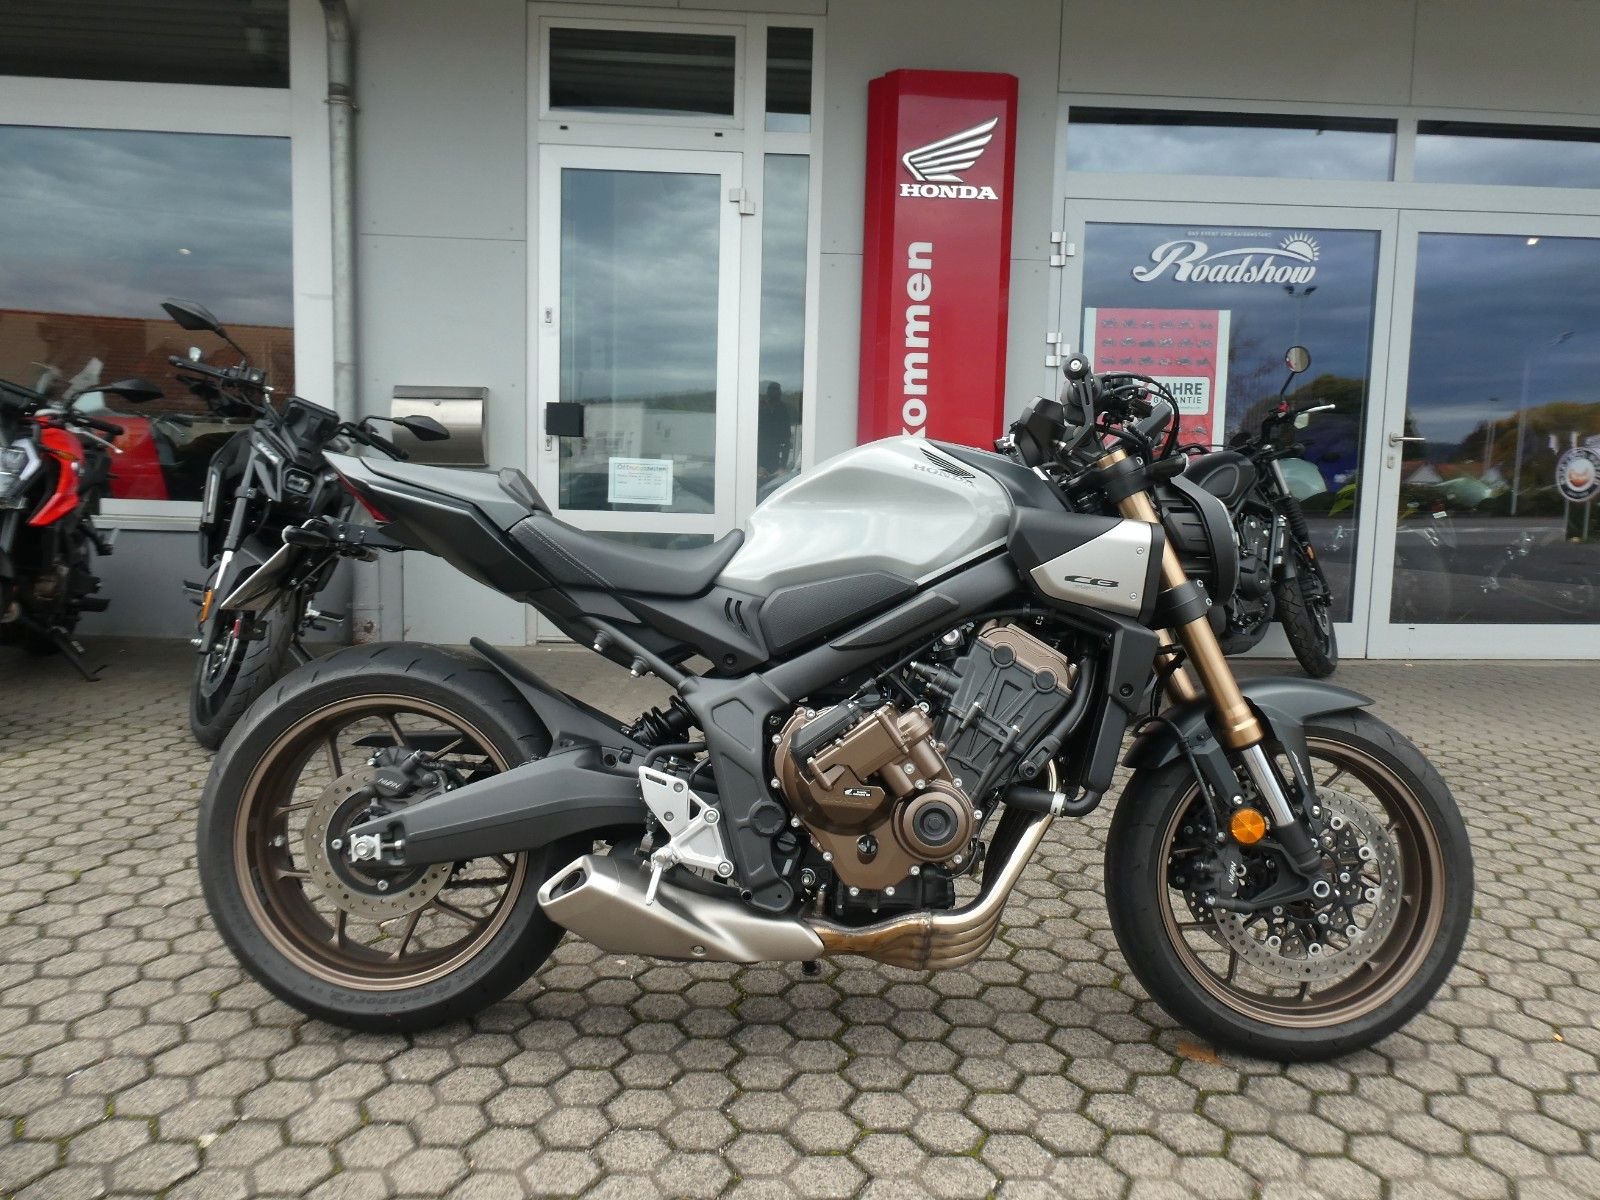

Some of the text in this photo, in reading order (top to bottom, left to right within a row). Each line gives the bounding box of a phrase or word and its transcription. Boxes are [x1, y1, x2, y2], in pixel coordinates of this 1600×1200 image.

[899, 183, 999, 200] HONDA
[1132, 239, 1317, 284] Roadshow
[1153, 396, 1202, 404] GANTIE
[1064, 575, 1119, 587] CB
